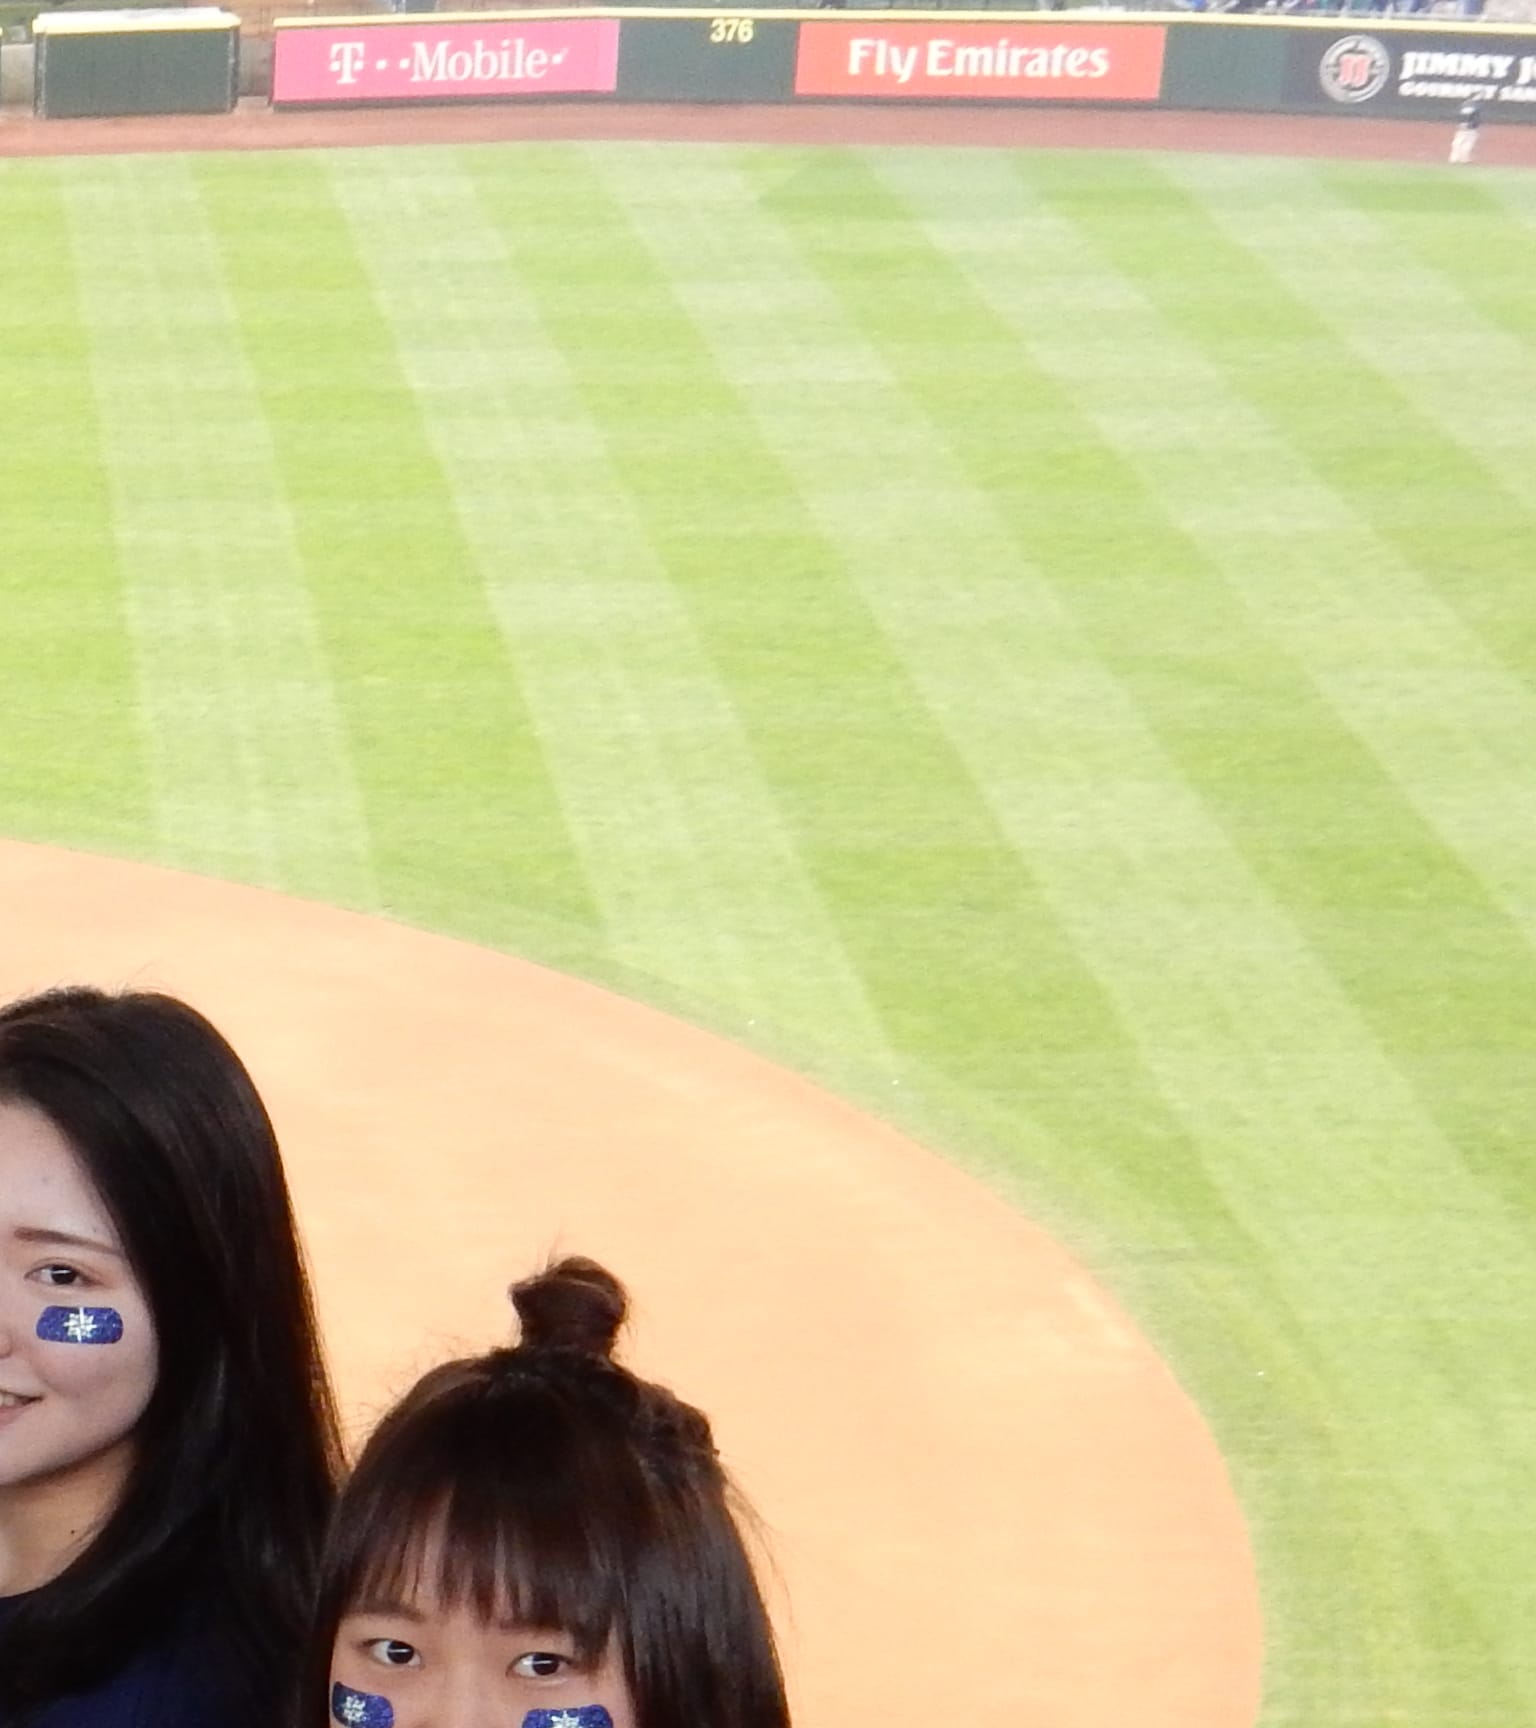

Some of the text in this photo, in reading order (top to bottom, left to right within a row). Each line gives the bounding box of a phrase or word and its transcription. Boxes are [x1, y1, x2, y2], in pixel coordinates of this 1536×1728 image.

[710, 19, 754, 44] 376
[847, 38, 1109, 83] Fly Emirates
